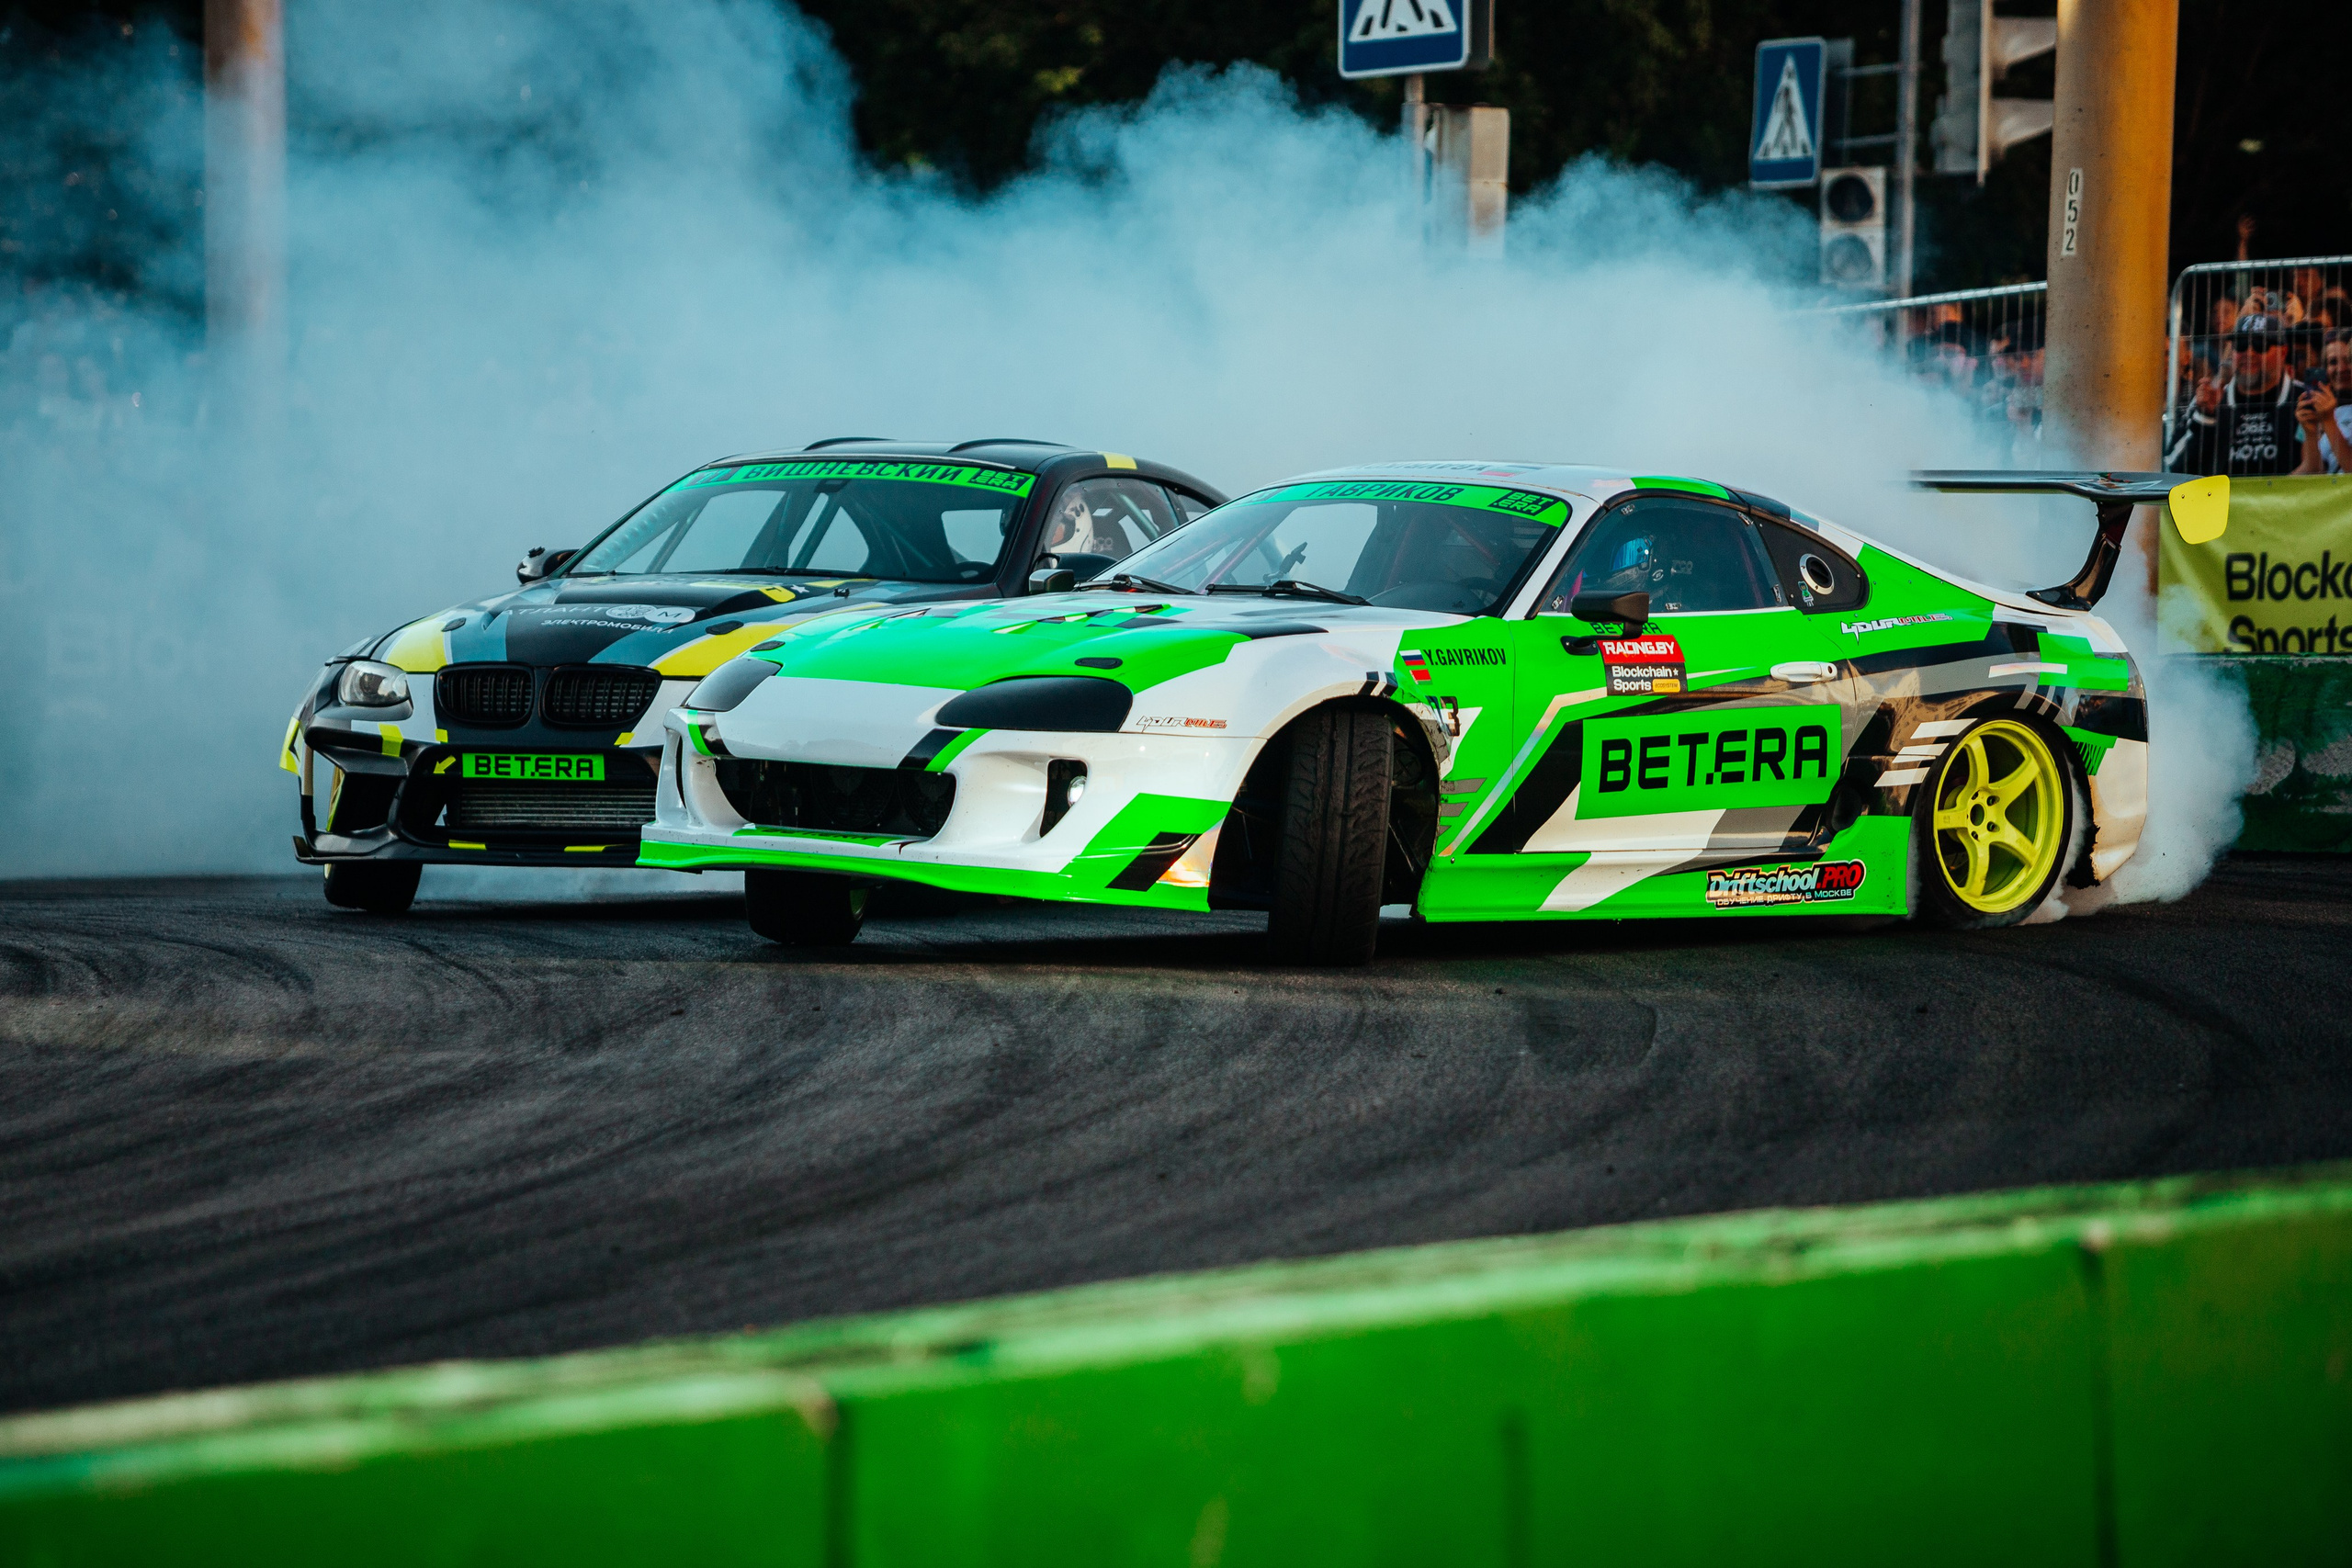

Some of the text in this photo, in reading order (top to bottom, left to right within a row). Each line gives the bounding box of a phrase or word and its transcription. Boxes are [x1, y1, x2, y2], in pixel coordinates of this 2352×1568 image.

[2065, 171, 2079, 251] 052
[980, 469, 1024, 481] BET
[1305, 483, 1464, 502] ГАВРИКОВ
[1508, 491, 1554, 505] BET
[1493, 499, 1542, 513] .ERA
[1422, 648, 1507, 666] Y.GAVRIKOV
[1611, 665, 1673, 678] Blockchain
[1613, 679, 1652, 694] Sports
[474, 754, 594, 778] BET.ERA
[1598, 725, 1828, 793] BET.ERA
